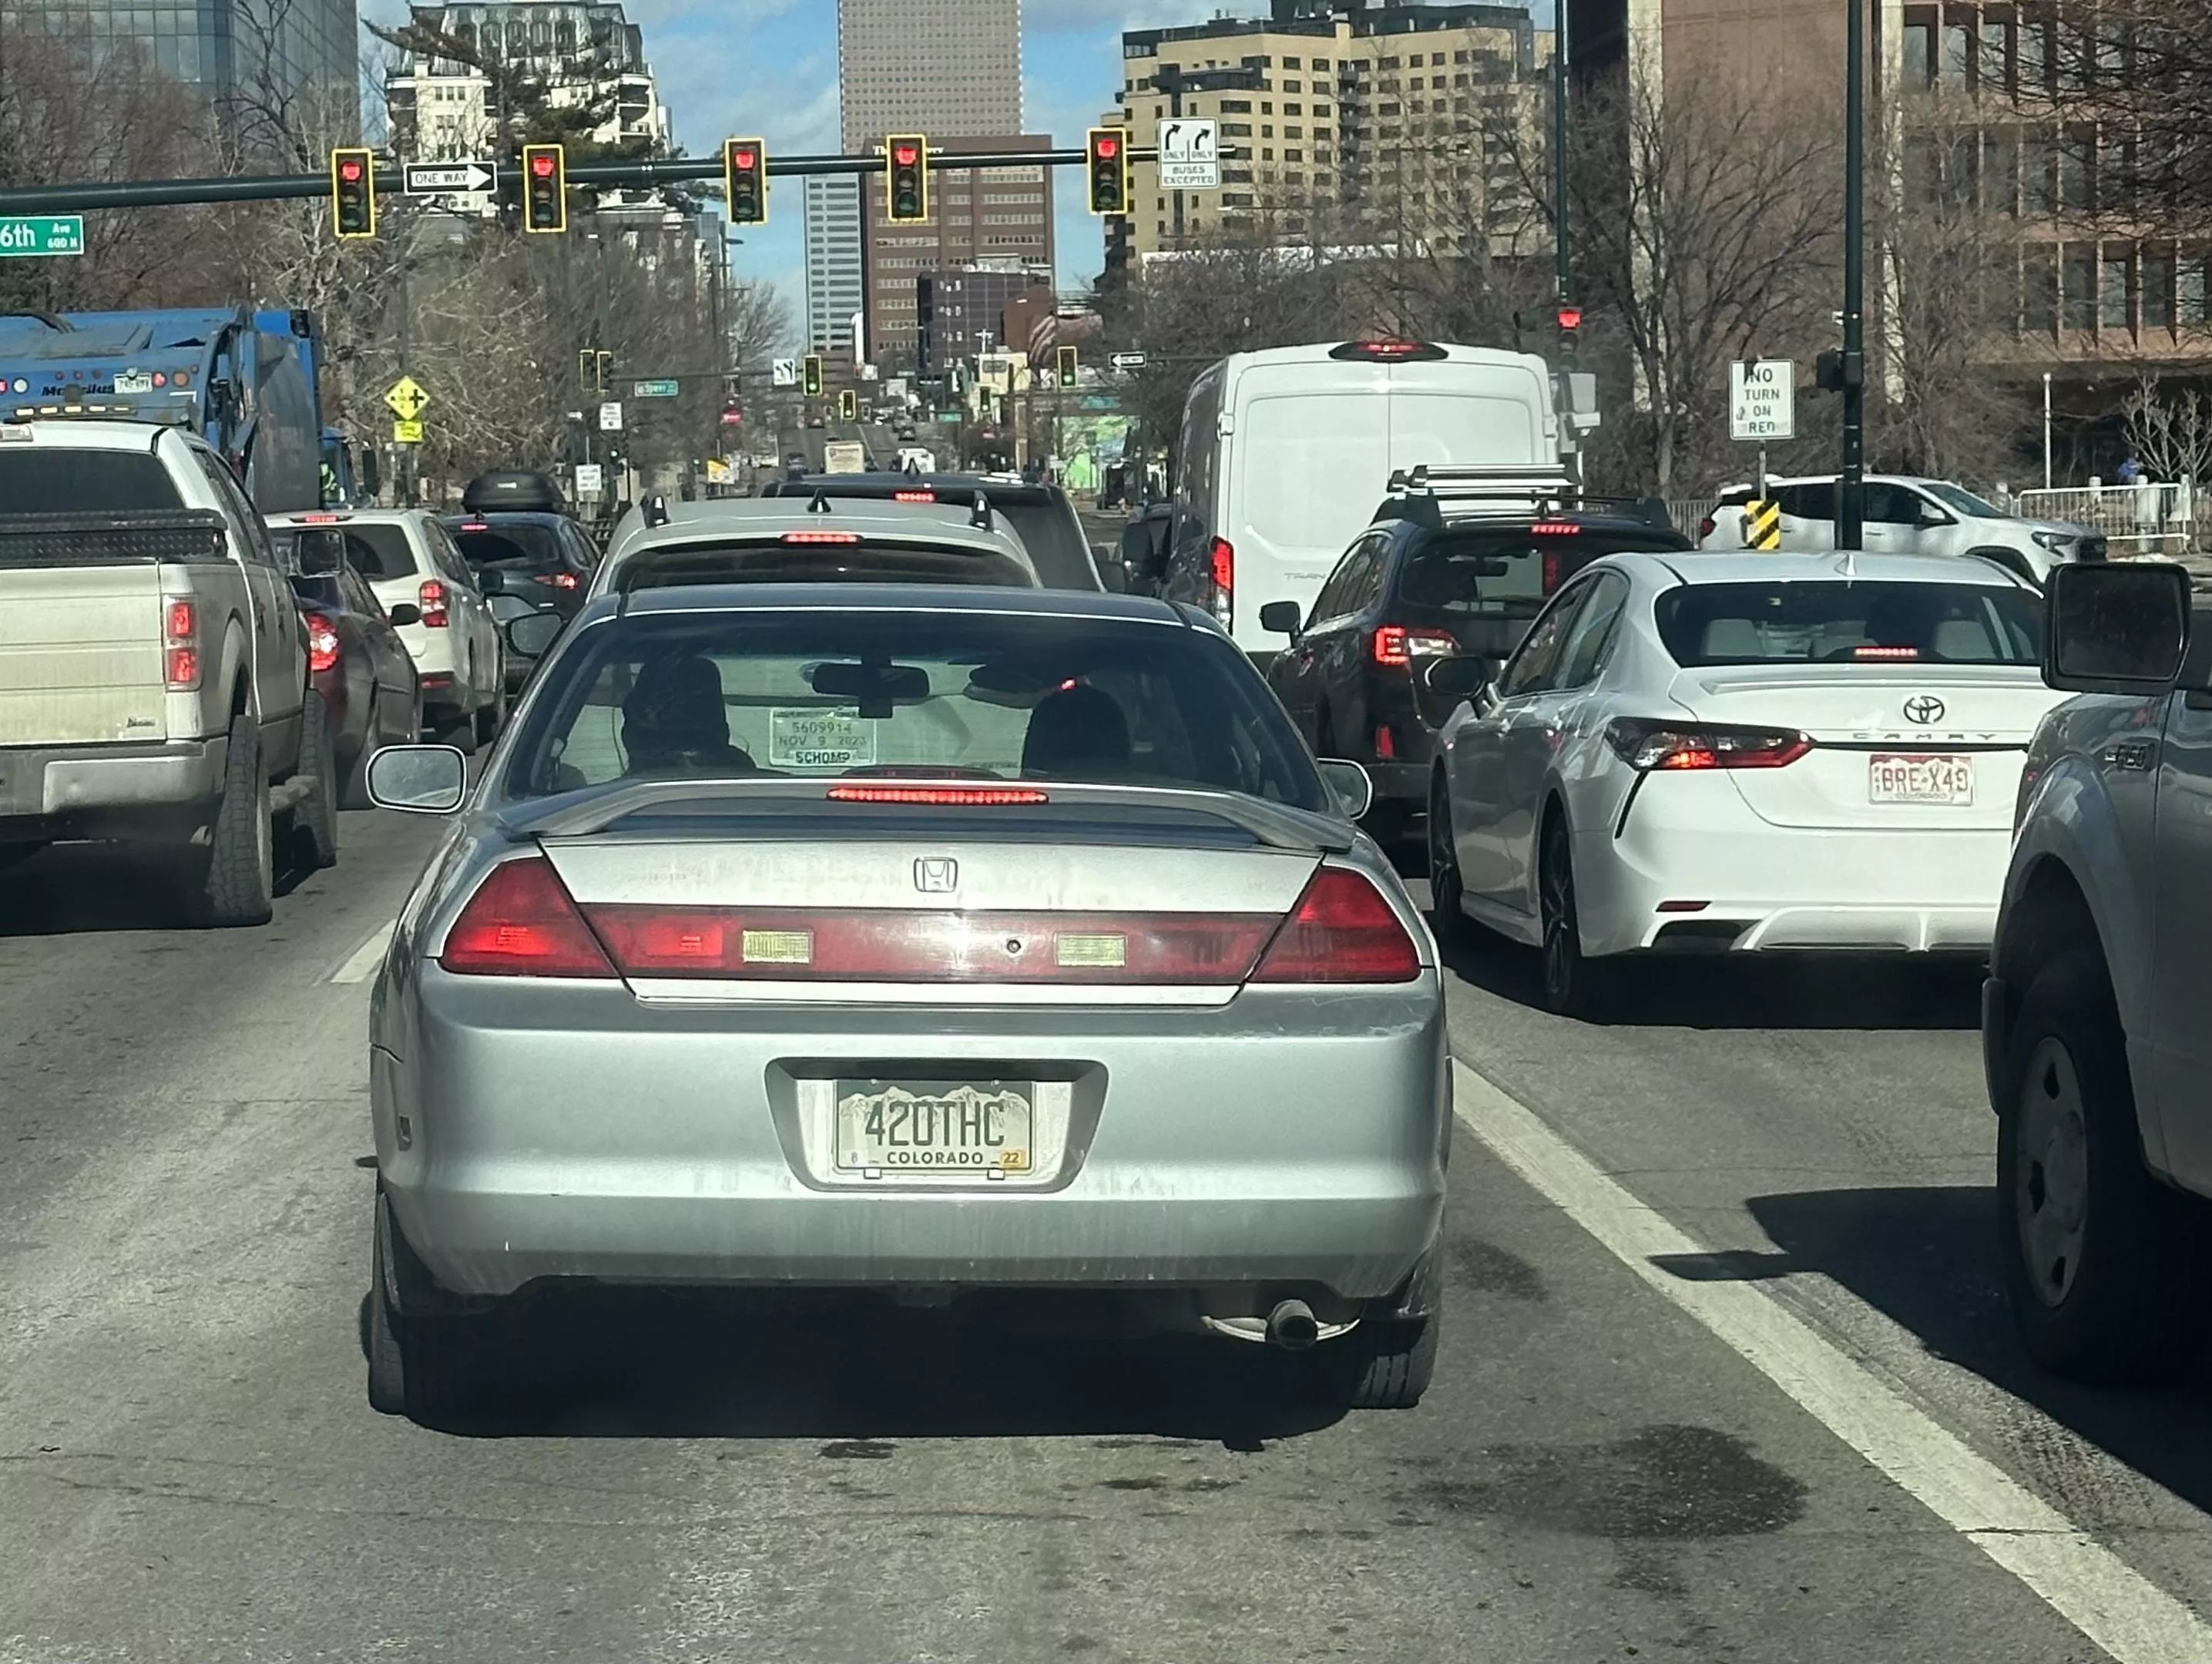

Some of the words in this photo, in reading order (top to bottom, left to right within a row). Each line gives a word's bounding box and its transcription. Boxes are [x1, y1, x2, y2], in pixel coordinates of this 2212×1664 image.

[1163, 151, 1185, 159] ONLY
[1191, 150, 1213, 159] ONLY
[1172, 166, 1205, 175] BUSES
[415, 173, 439, 184] ONE
[443, 173, 467, 183] WAY
[1163, 176, 1214, 185] EXCEPTED
[52, 222, 71, 234] Ave
[0, 223, 36, 247] 6th
[69, 237, 78, 247] N
[1750, 368, 1773, 383] NO
[1744, 388, 1780, 401] TURN
[1753, 404, 1771, 418] ON
[778, 735, 807, 746] NOV
[864, 1099, 1005, 1147] 420THC
[886, 1151, 984, 1165] COLORADO
[1003, 1152, 1020, 1164] 22
